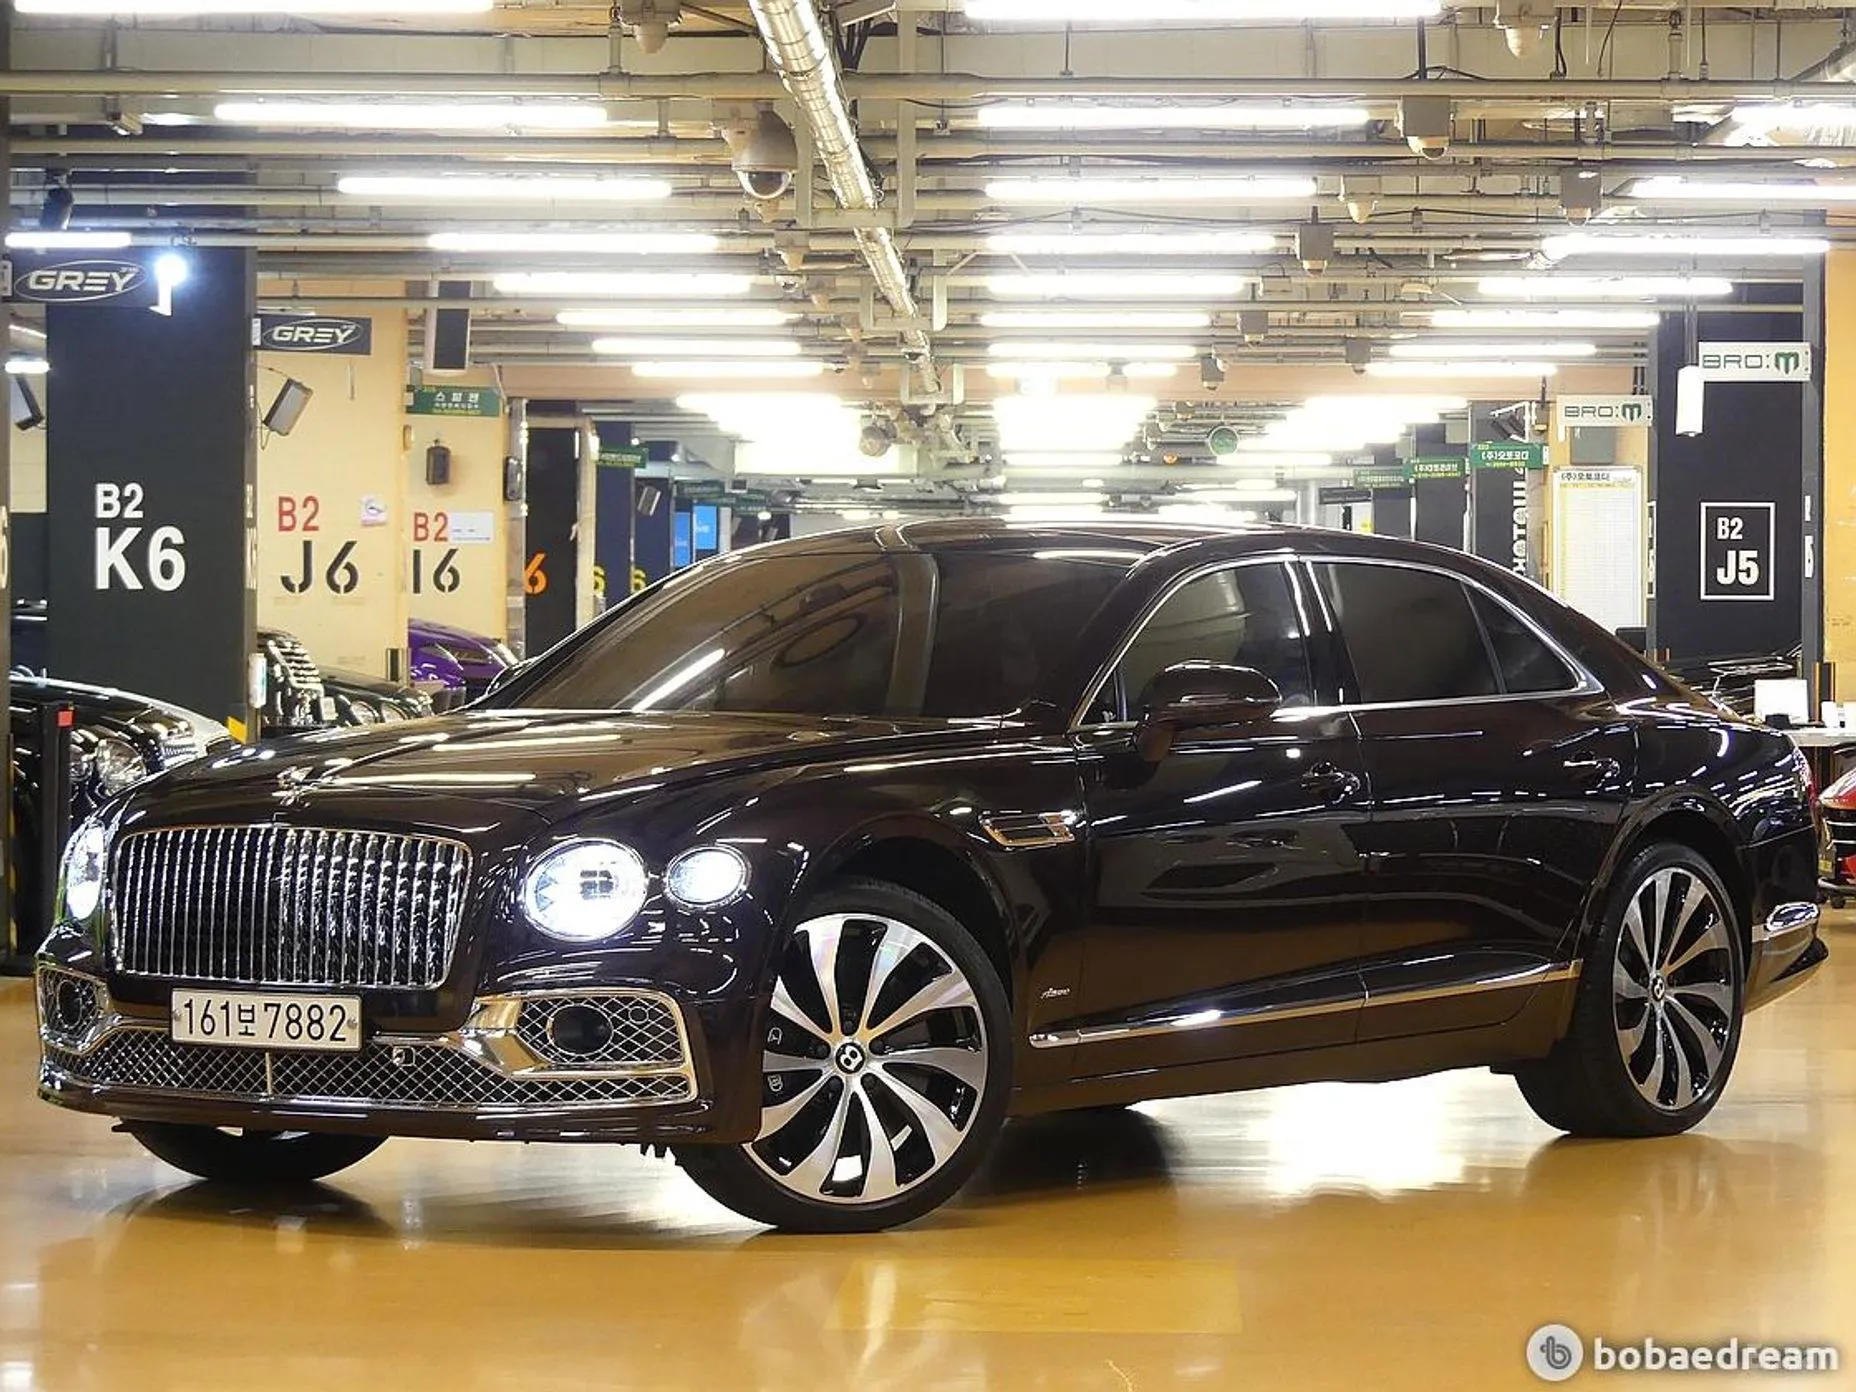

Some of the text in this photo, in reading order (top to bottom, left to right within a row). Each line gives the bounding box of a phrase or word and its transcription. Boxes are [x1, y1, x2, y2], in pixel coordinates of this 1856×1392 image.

[28, 267, 138, 292] GREY
[272, 325, 356, 343] GREY
[94, 482, 144, 519] B2
[277, 495, 321, 532] B2
[412, 511, 449, 543] B2
[1716, 516, 1743, 540] B2
[94, 526, 187, 592] K6
[280, 540, 360, 595] J6
[1716, 549, 1760, 585] J5
